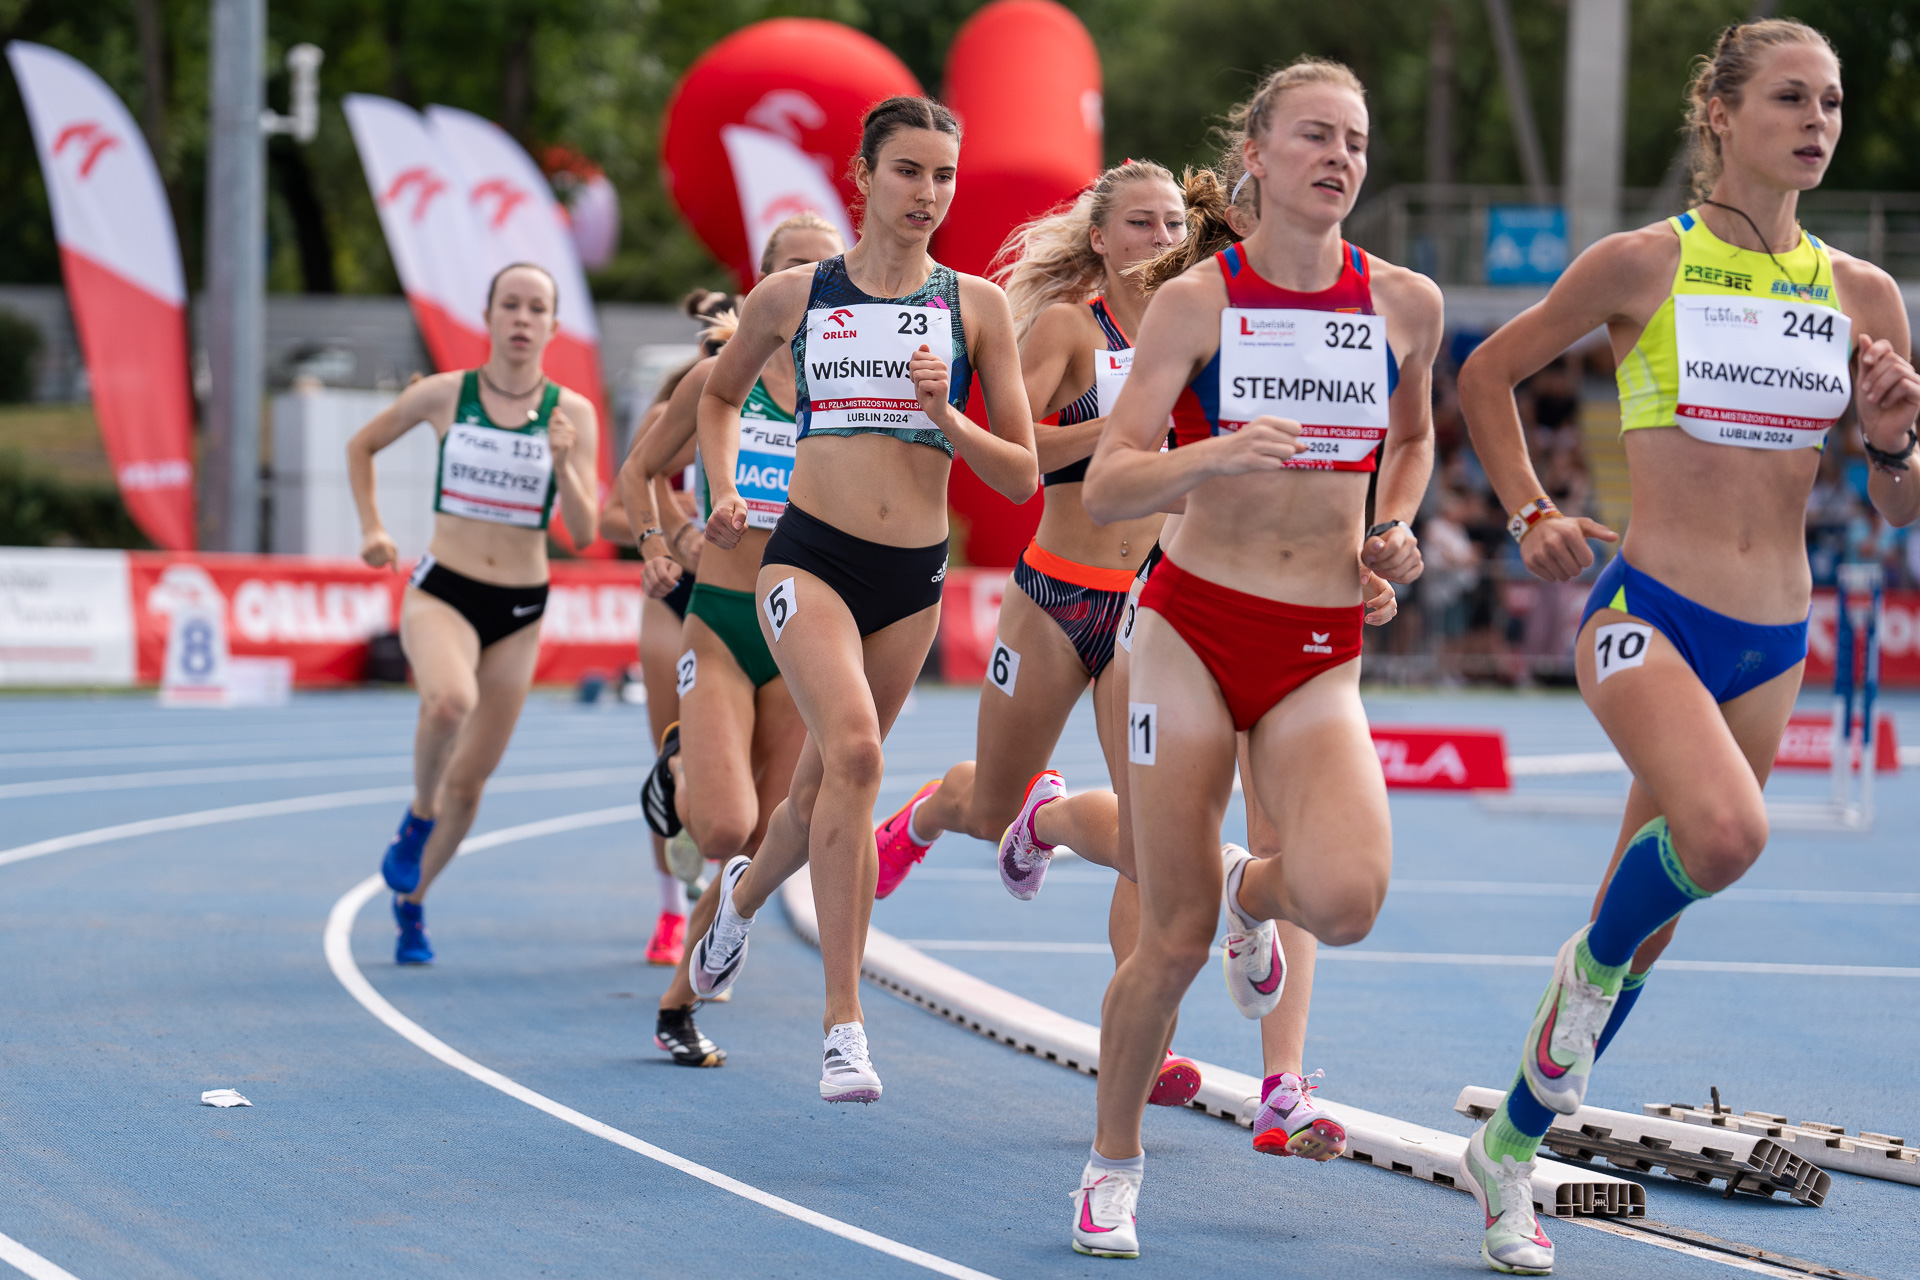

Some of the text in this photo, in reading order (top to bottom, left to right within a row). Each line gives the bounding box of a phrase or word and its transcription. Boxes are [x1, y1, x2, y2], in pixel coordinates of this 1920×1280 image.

[823, 330, 857, 340] ORLEN
[898, 312, 928, 335] 23
[1325, 321, 1372, 350] 322
[1783, 310, 1834, 343] 244
[1686, 360, 1845, 394] KRAWCZYŃSKA
[1233, 377, 1377, 405] STEMPNIAK
[847, 400, 898, 408] MISTRZOSTWA
[847, 413, 909, 423] LUBLIN 2024
[1720, 411, 1785, 426] MISTRZOSTWA
[755, 431, 796, 447] FUEL
[1330, 428, 1361, 438] POLSKI
[1720, 427, 1793, 443] LUBLIN 2024
[1310, 442, 1339, 453] 2024
[735, 464, 794, 492] JAGU
[770, 585, 788, 628] 5
[181, 618, 215, 682] 8
[1597, 632, 1645, 669] 10
[993, 647, 1010, 685] 6
